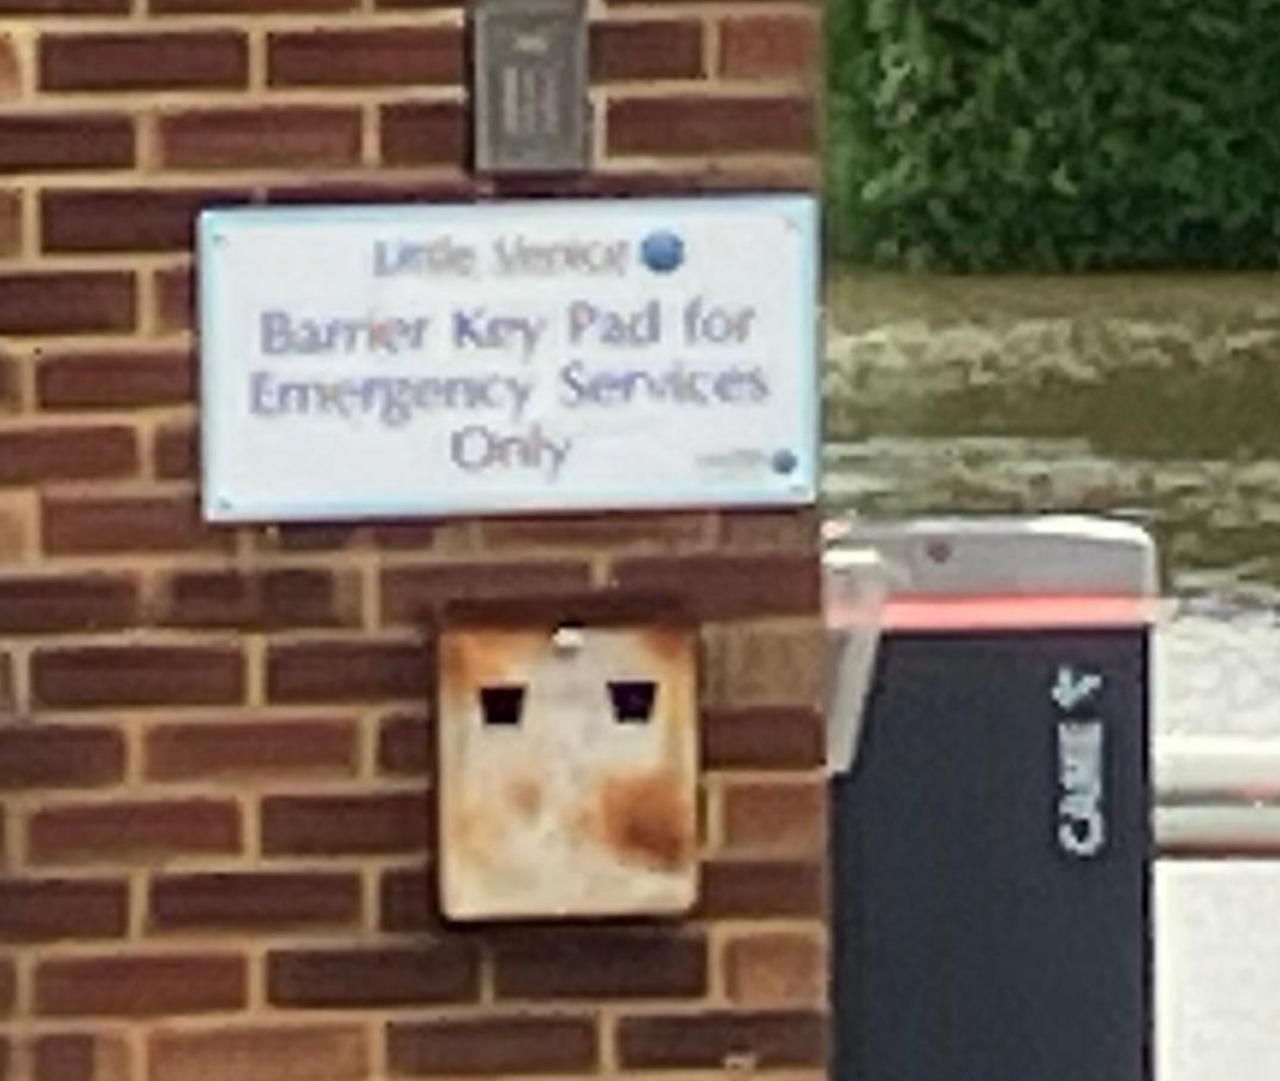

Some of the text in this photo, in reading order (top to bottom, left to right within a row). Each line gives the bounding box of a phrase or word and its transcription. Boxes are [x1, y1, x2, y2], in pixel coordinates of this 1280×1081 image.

[260, 295, 756, 362] Barrier Key Pad for
[249, 358, 770, 422] Emergency Services
[451, 424, 573, 479] Only
